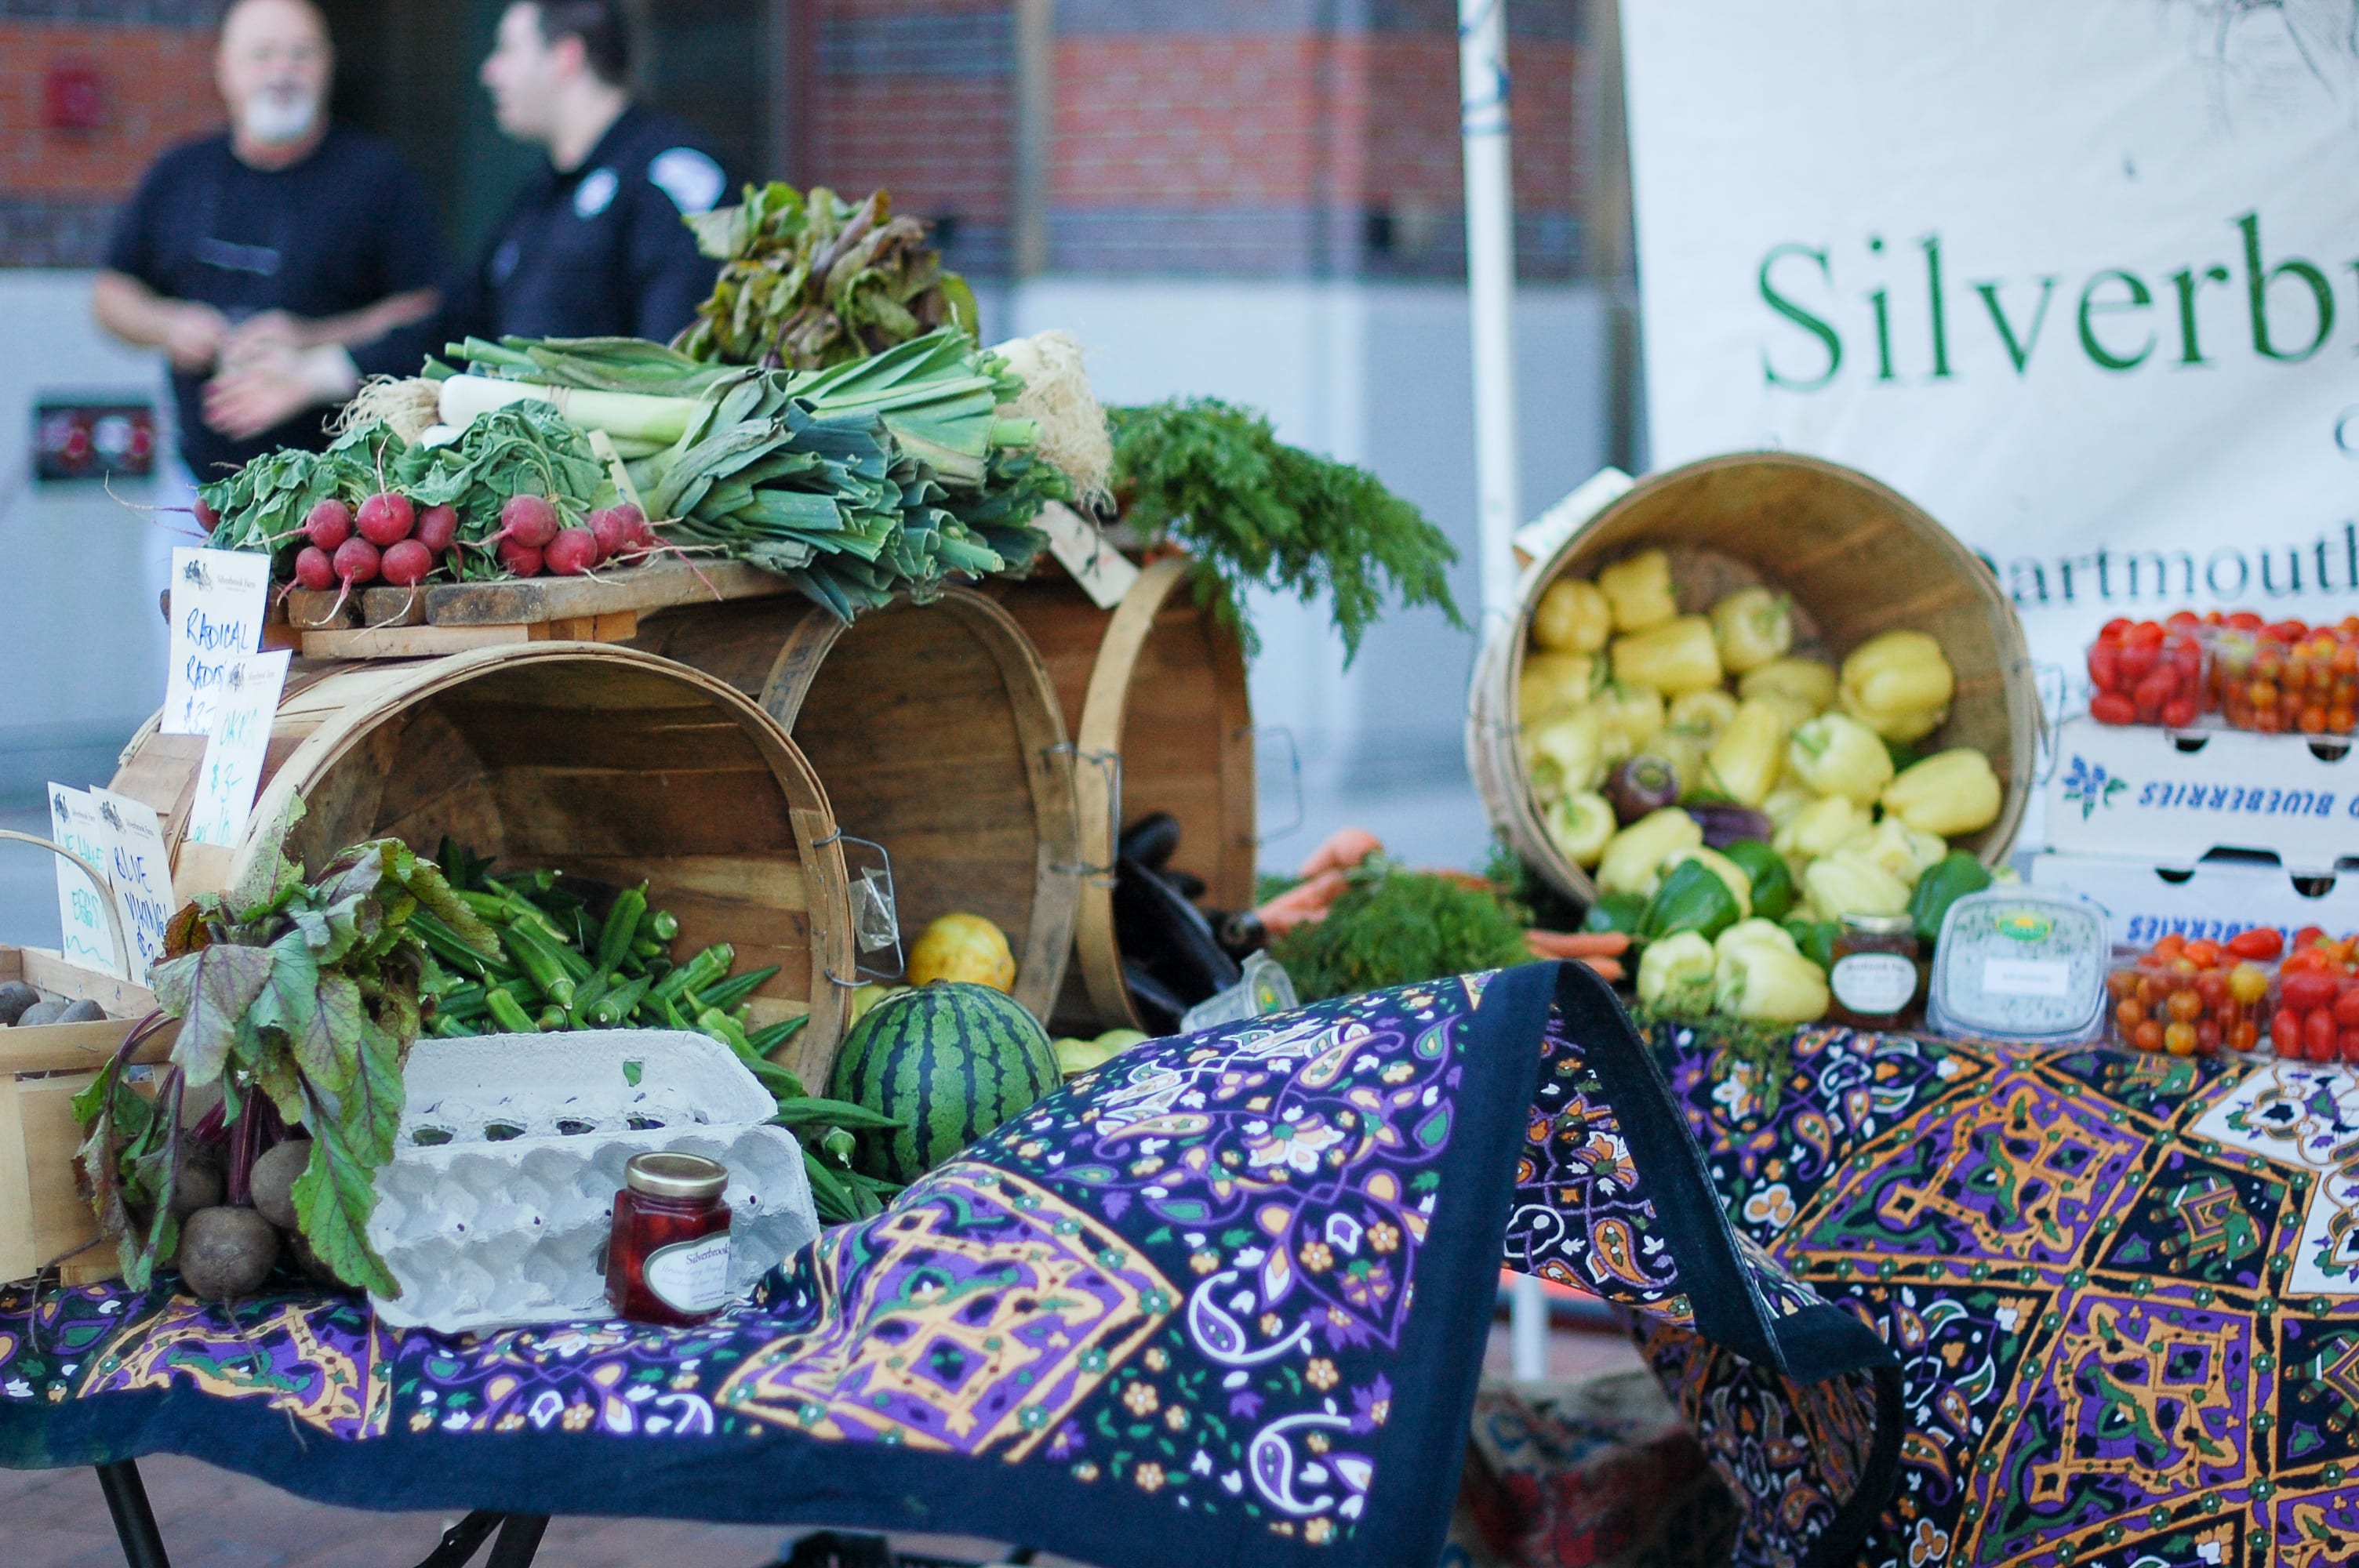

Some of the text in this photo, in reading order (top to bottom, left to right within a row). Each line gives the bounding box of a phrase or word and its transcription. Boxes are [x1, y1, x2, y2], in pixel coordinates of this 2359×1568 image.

[1755, 209, 2359, 394] Silverb
[1975, 521, 2359, 605] artmout
[187, 608, 248, 654] RADICAL
[187, 655, 226, 691] RADIS
[2139, 782, 2335, 817] BLUEBERRIES
[114, 846, 152, 893] BLUE
